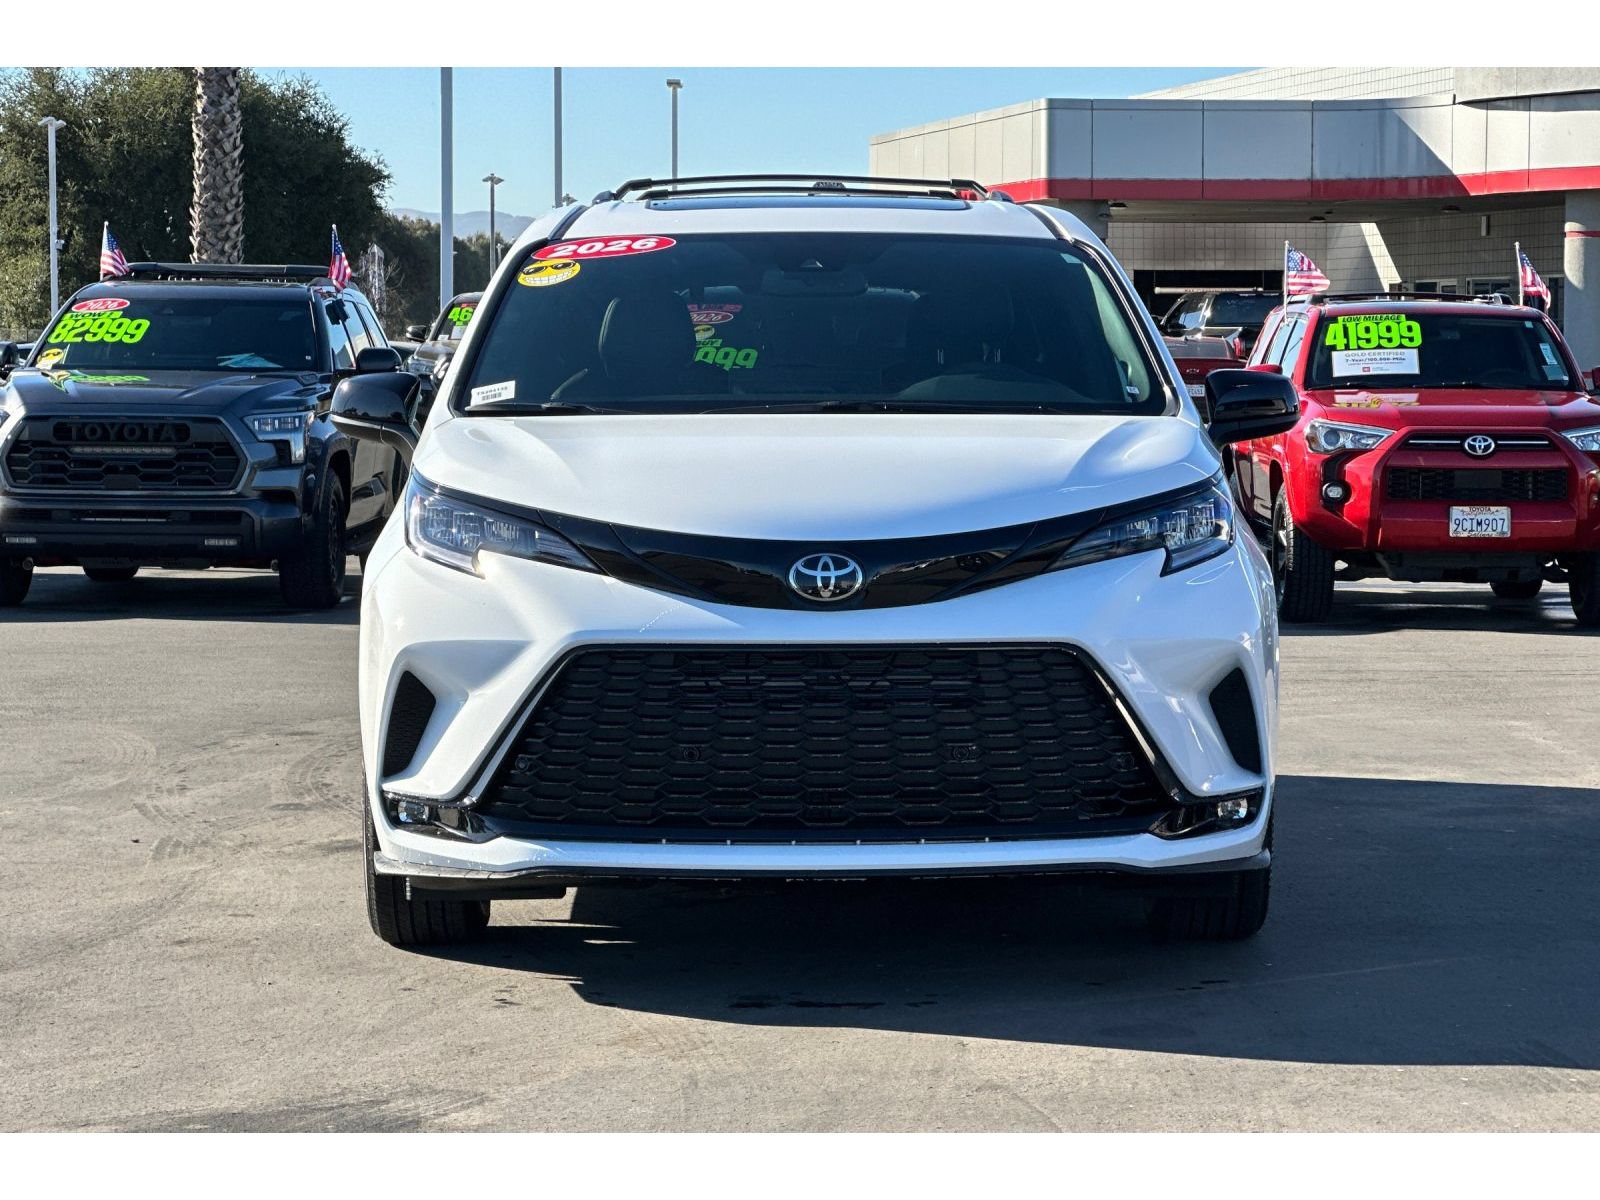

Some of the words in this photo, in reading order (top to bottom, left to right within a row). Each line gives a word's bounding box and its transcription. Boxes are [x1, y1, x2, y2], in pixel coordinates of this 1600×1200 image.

[547, 238, 660, 258] 2026
[82, 300, 118, 310] 2026
[47, 318, 150, 344] 82999
[1325, 321, 1422, 350] 41999
[67, 422, 177, 441] TOYOTA
[1453, 517, 1506, 532] 9CIM907
